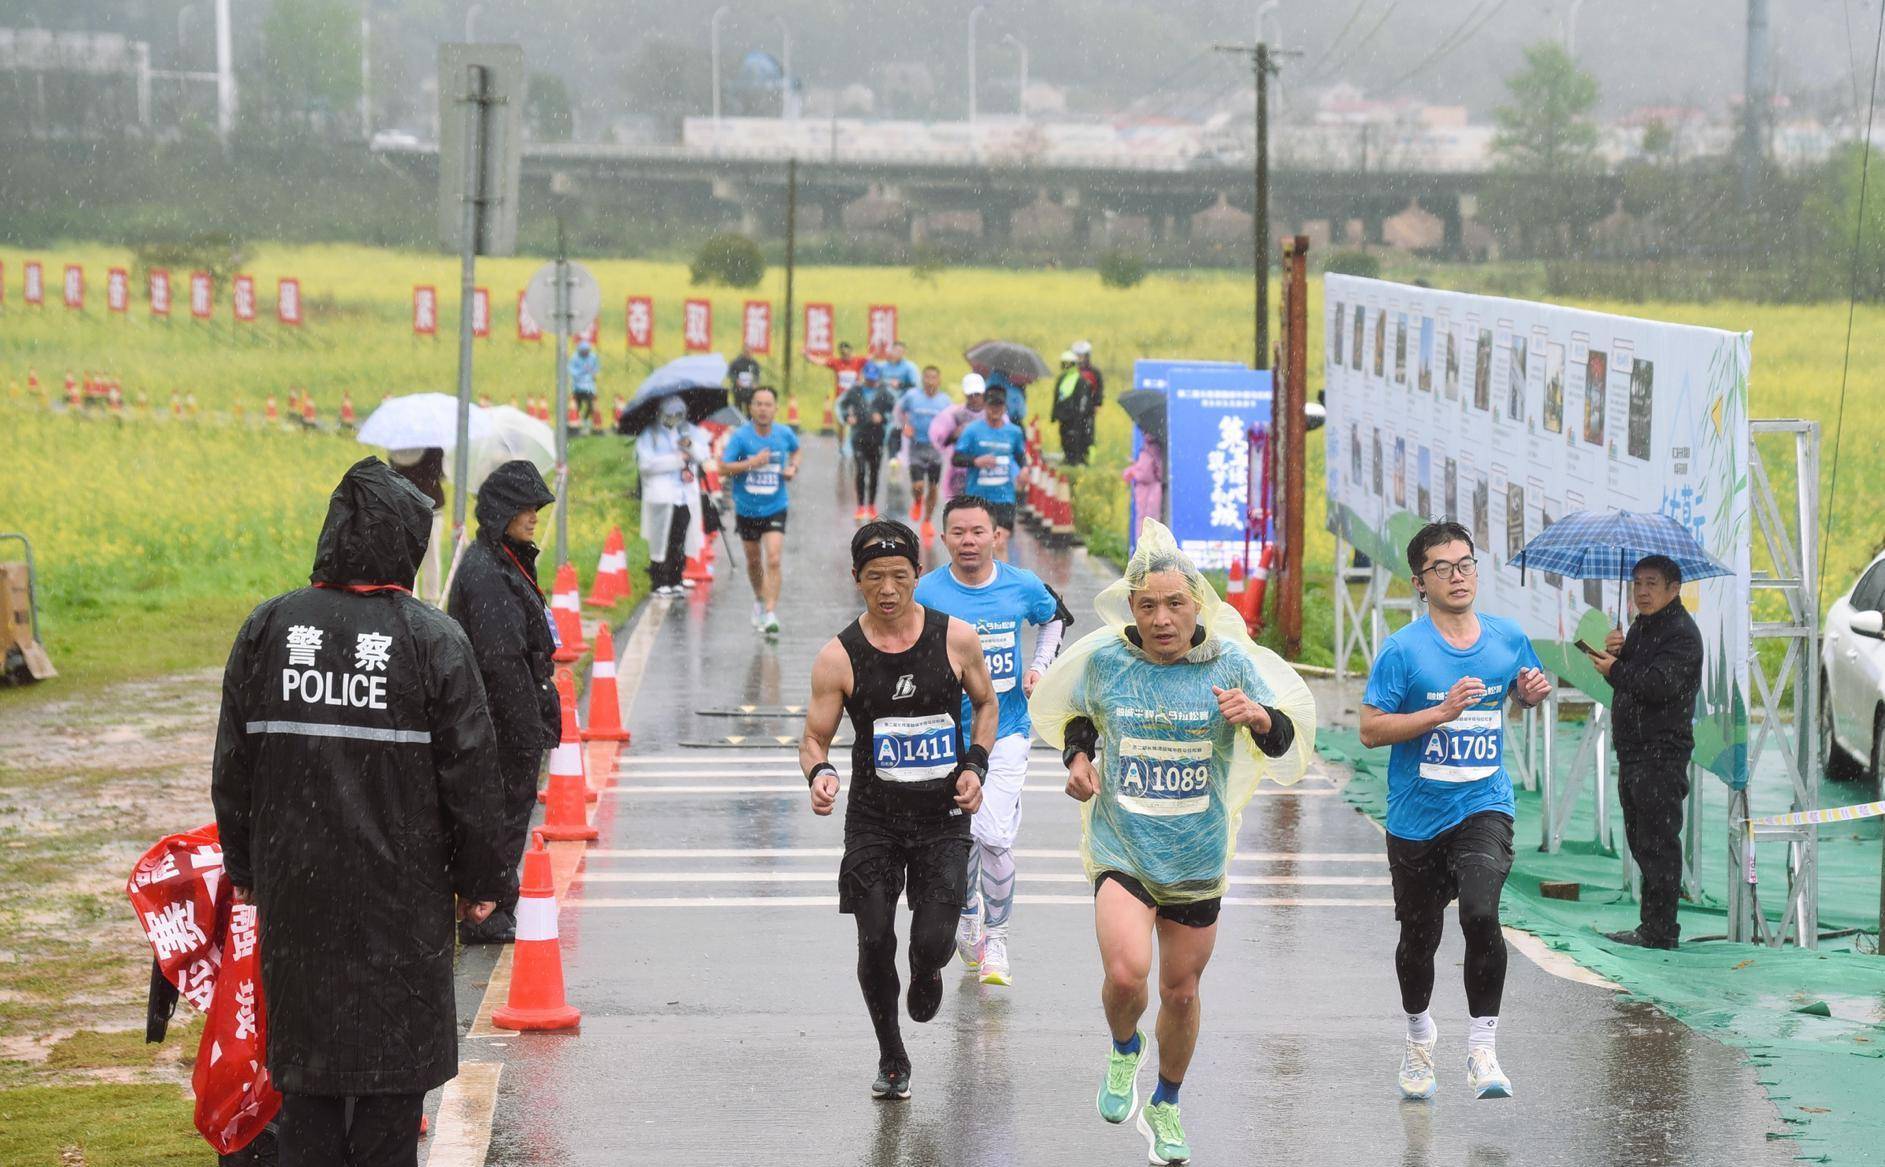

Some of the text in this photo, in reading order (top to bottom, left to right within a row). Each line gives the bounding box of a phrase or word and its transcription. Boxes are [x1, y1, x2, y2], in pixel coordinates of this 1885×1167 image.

[628, 301, 650, 344] 夺
[686, 304, 709, 346] 取
[746, 304, 768, 352] 新
[807, 307, 831, 351] 胜
[871, 309, 894, 352] 利
[286, 625, 393, 671] 警察
[282, 668, 388, 709] POLICE
[1168, 711, 1209, 721] 马拉松赛
[878, 735, 955, 761] A 1411
[1425, 733, 1497, 760] A 1705
[1123, 762, 1208, 792] A 1089
